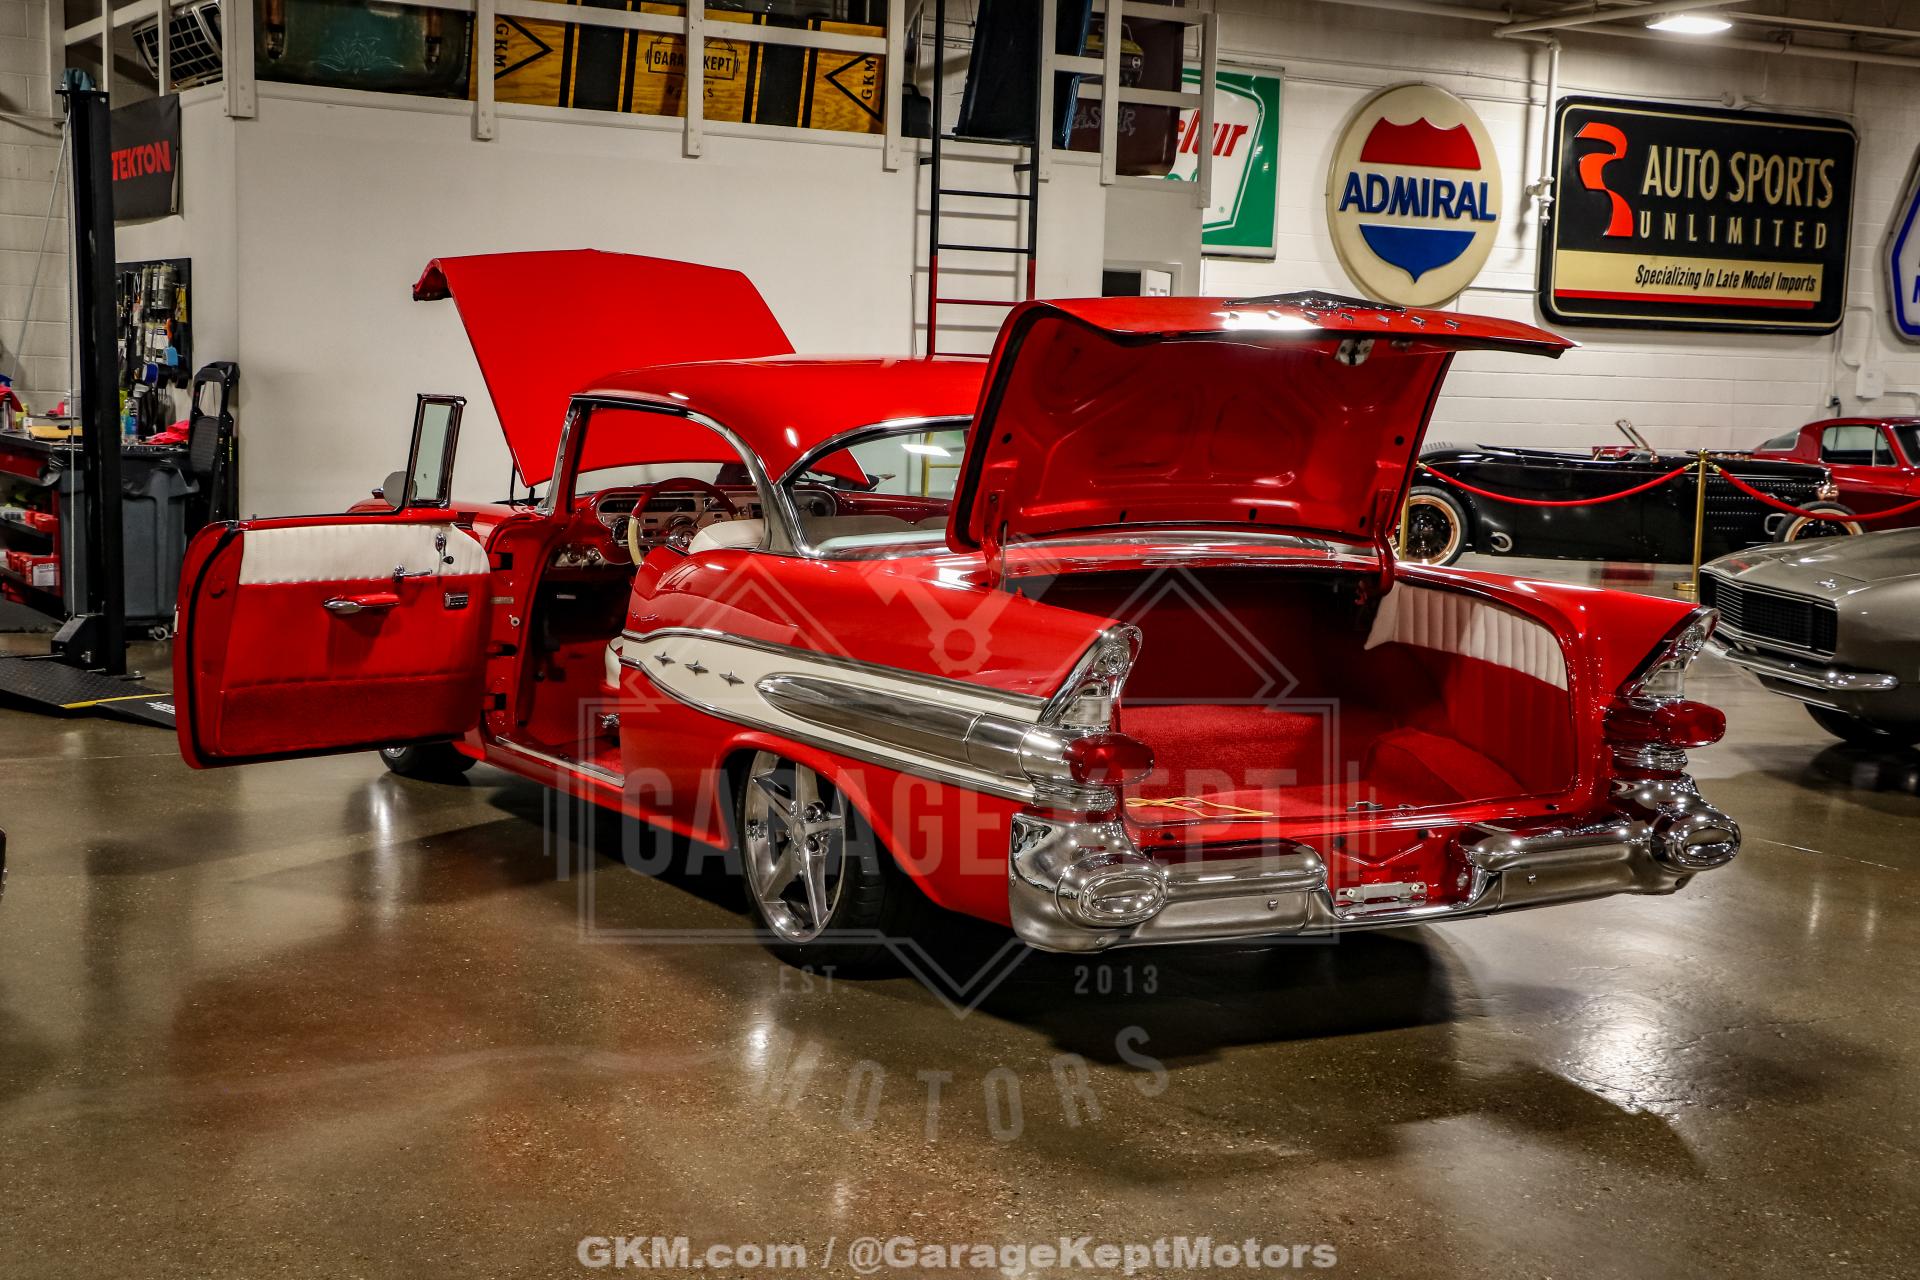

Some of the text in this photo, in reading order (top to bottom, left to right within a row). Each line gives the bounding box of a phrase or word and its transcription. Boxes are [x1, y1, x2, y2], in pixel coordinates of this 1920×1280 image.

[654, 50, 685, 67] GARA
[862, 59, 877, 100] GKM
[111, 140, 171, 181] TEKTON
[1641, 143, 1835, 209] AUTO SPORTS
[1338, 171, 1497, 222] ADMIRAL
[1640, 210, 1828, 250] UNLIMITED
[1635, 264, 1817, 293] Specializing In Late Model Imports
